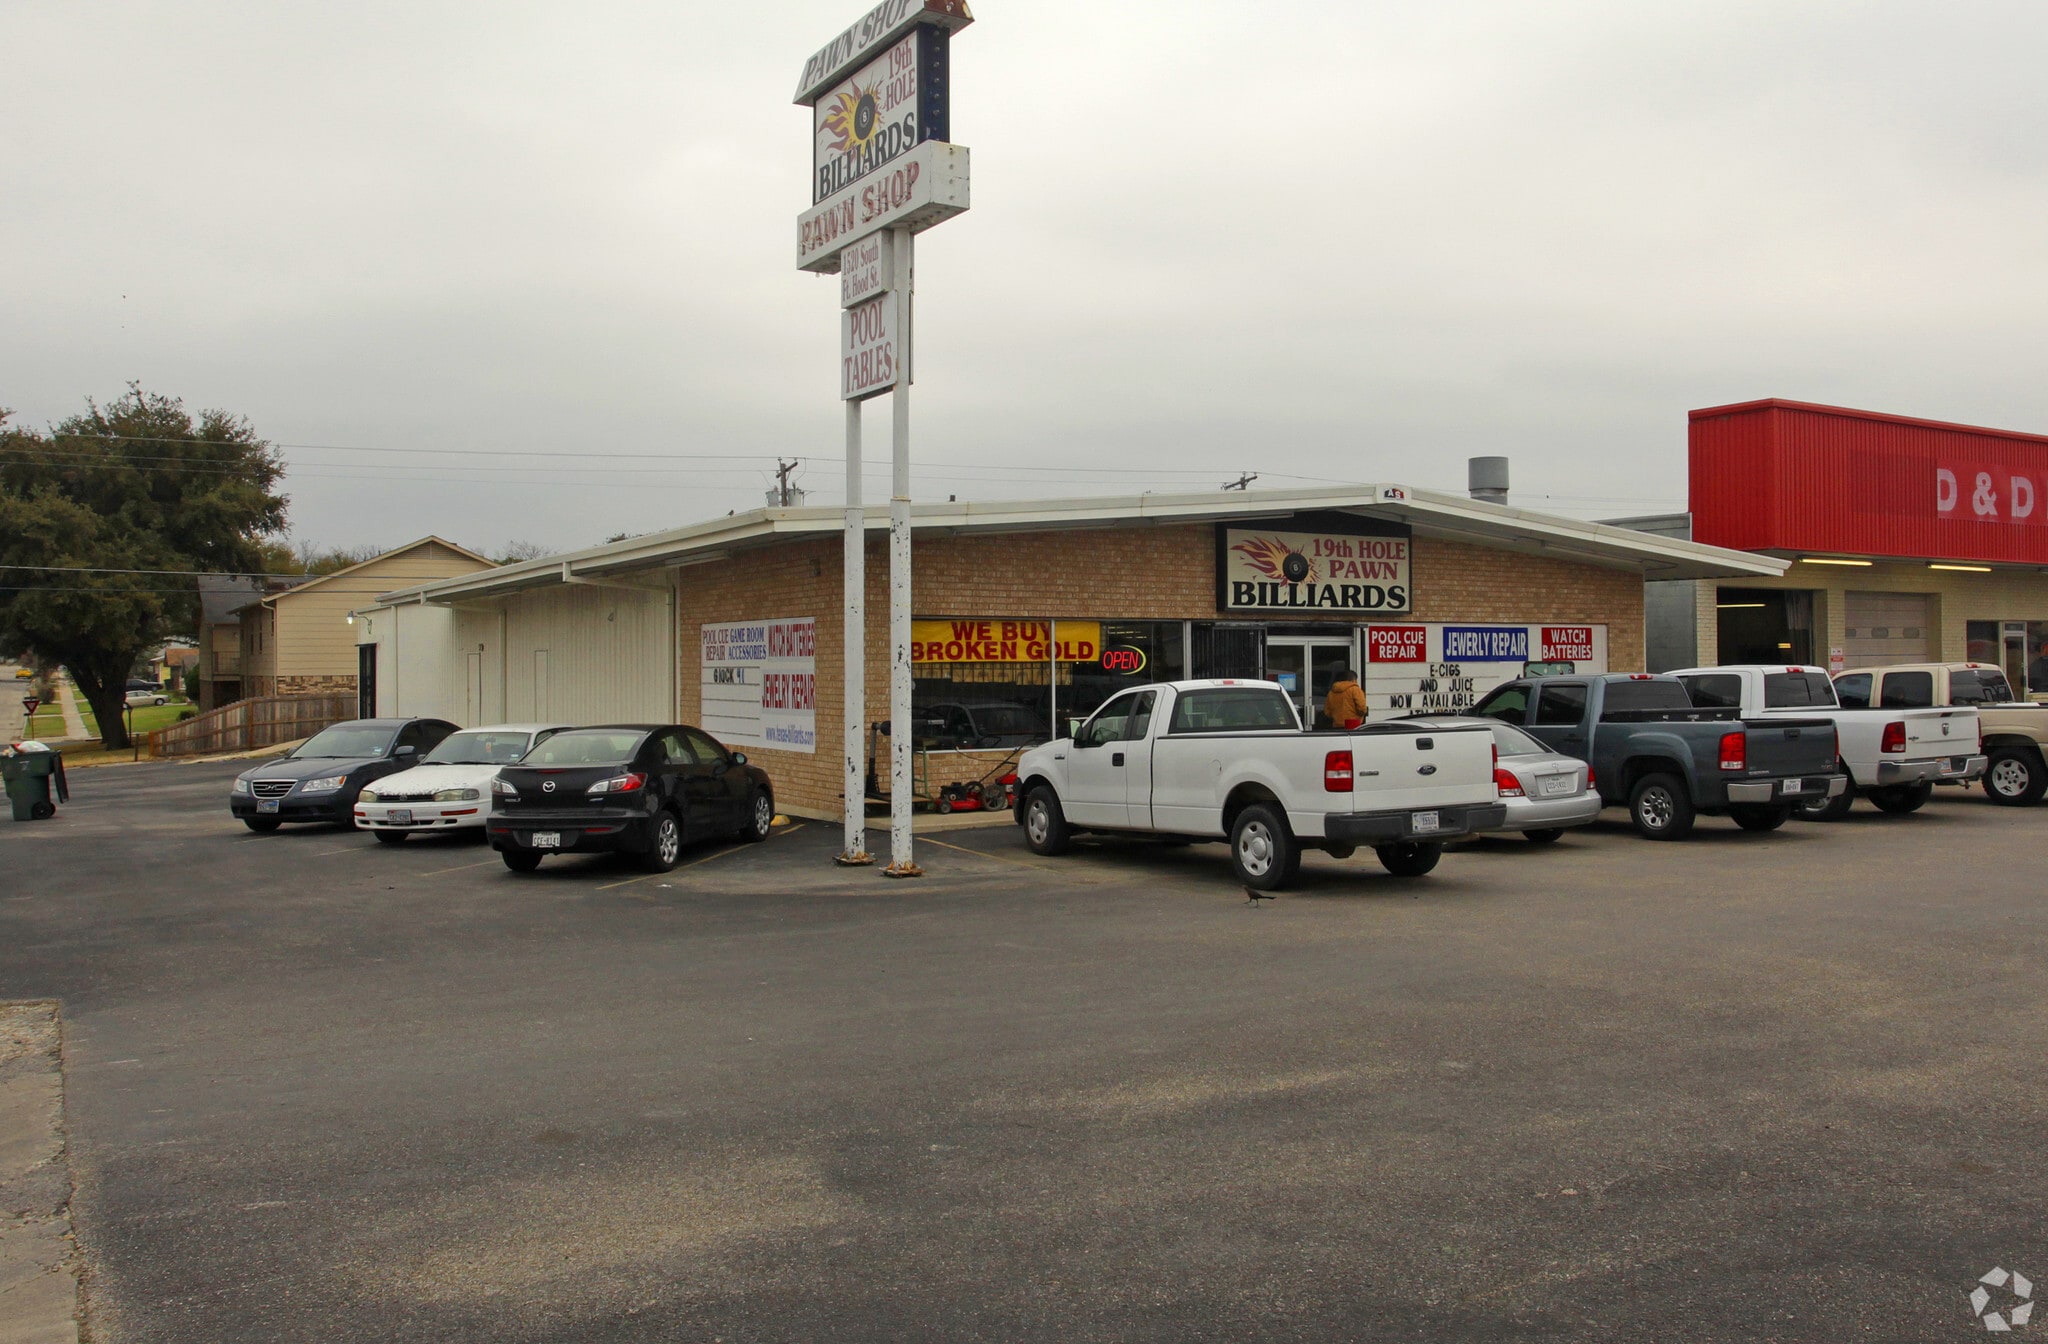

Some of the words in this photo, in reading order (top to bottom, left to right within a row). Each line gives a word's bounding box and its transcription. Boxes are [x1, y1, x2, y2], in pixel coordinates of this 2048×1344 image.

[802, 25, 858, 91] PAWN
[888, 40, 913, 79] 19th
[885, 69, 916, 112] HOLE
[818, 112, 915, 200] BILLIARDS
[801, 195, 856, 256] PAWN
[861, 160, 920, 224] SHOP
[860, 237, 879, 267] South
[852, 267, 869, 297] Hood
[850, 300, 885, 350] POOL
[844, 341, 892, 394] TABLES
[1937, 468, 1957, 511] D
[1973, 472, 1998, 515] &
[2011, 476, 2034, 517] D
[1312, 538, 1353, 558] 19th
[1358, 540, 1406, 560] HOLE
[1329, 560, 1398, 580] PAWN
[1232, 581, 1405, 609] BILLIARDS
[703, 629, 718, 645] POOL
[718, 628, 729, 644] CUE
[730, 628, 745, 643] GAME
[746, 627, 765, 642] ROOM
[951, 622, 992, 640] WE
[1002, 621, 1051, 641] BUY
[1371, 631, 1402, 645] POOL
[1403, 631, 1424, 645] CUE
[1551, 629, 1586, 643] WATCH
[706, 645, 726, 661] REPAIR
[728, 645, 767, 660] ACCESSORIES
[912, 641, 1017, 660] BROKEN
[1026, 641, 1093, 660] GOLD
[1379, 645, 1417, 659] REPAIR
[1446, 632, 1490, 657] JEWERLY
[1492, 632, 1527, 656] REPAIR
[1543, 645, 1592, 659] BATTERIES
[1103, 651, 1139, 670] OPEN
[1430, 664, 1461, 677] E-CIGS
[762, 674, 790, 709] JEWELRY
[791, 674, 815, 709] REPAIR
[1419, 679, 1438, 692] AND
[1449, 678, 1474, 692] JUICE
[1390, 694, 1412, 708] NOW
[1422, 693, 1474, 708] AVAILABLE
